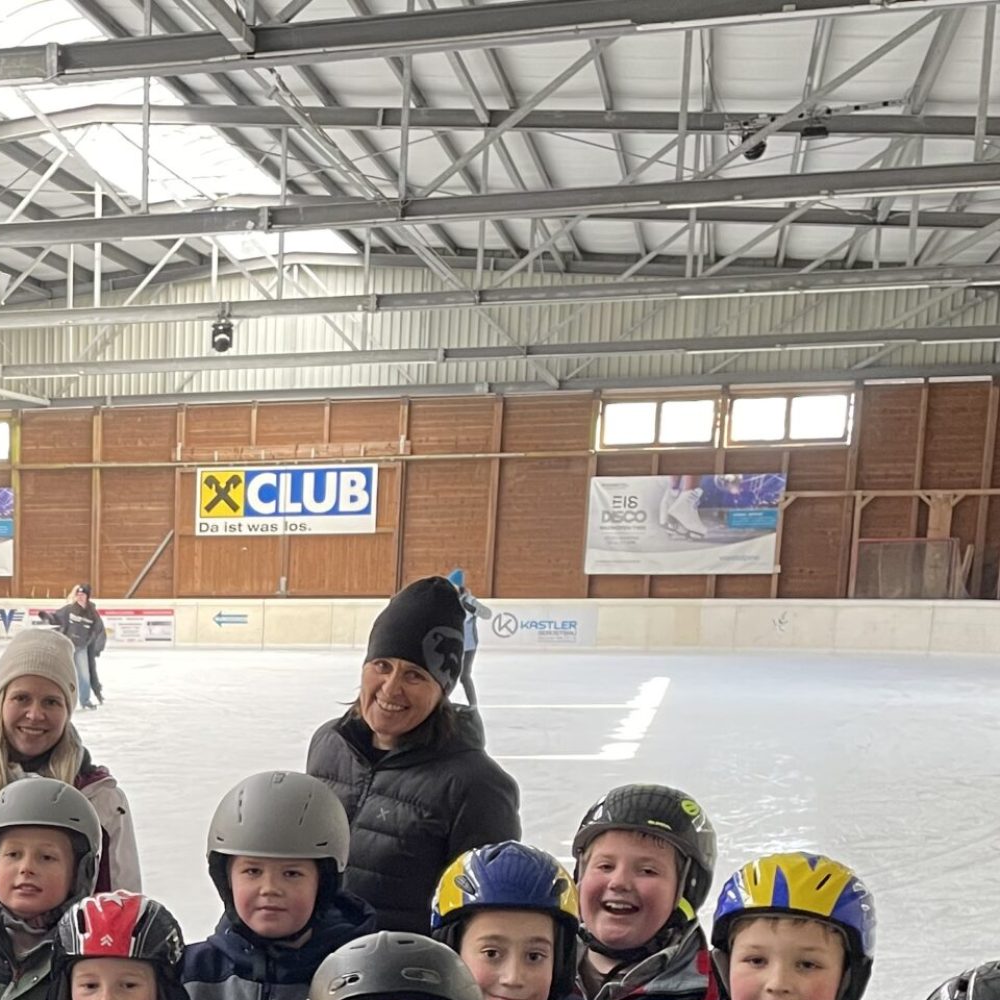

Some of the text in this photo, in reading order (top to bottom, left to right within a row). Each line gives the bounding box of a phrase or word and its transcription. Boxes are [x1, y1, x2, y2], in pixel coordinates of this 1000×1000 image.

[247, 471, 369, 514] CLUB
[199, 520, 312, 533] Da ist was los.
[520, 621, 577, 630] KASTLER
